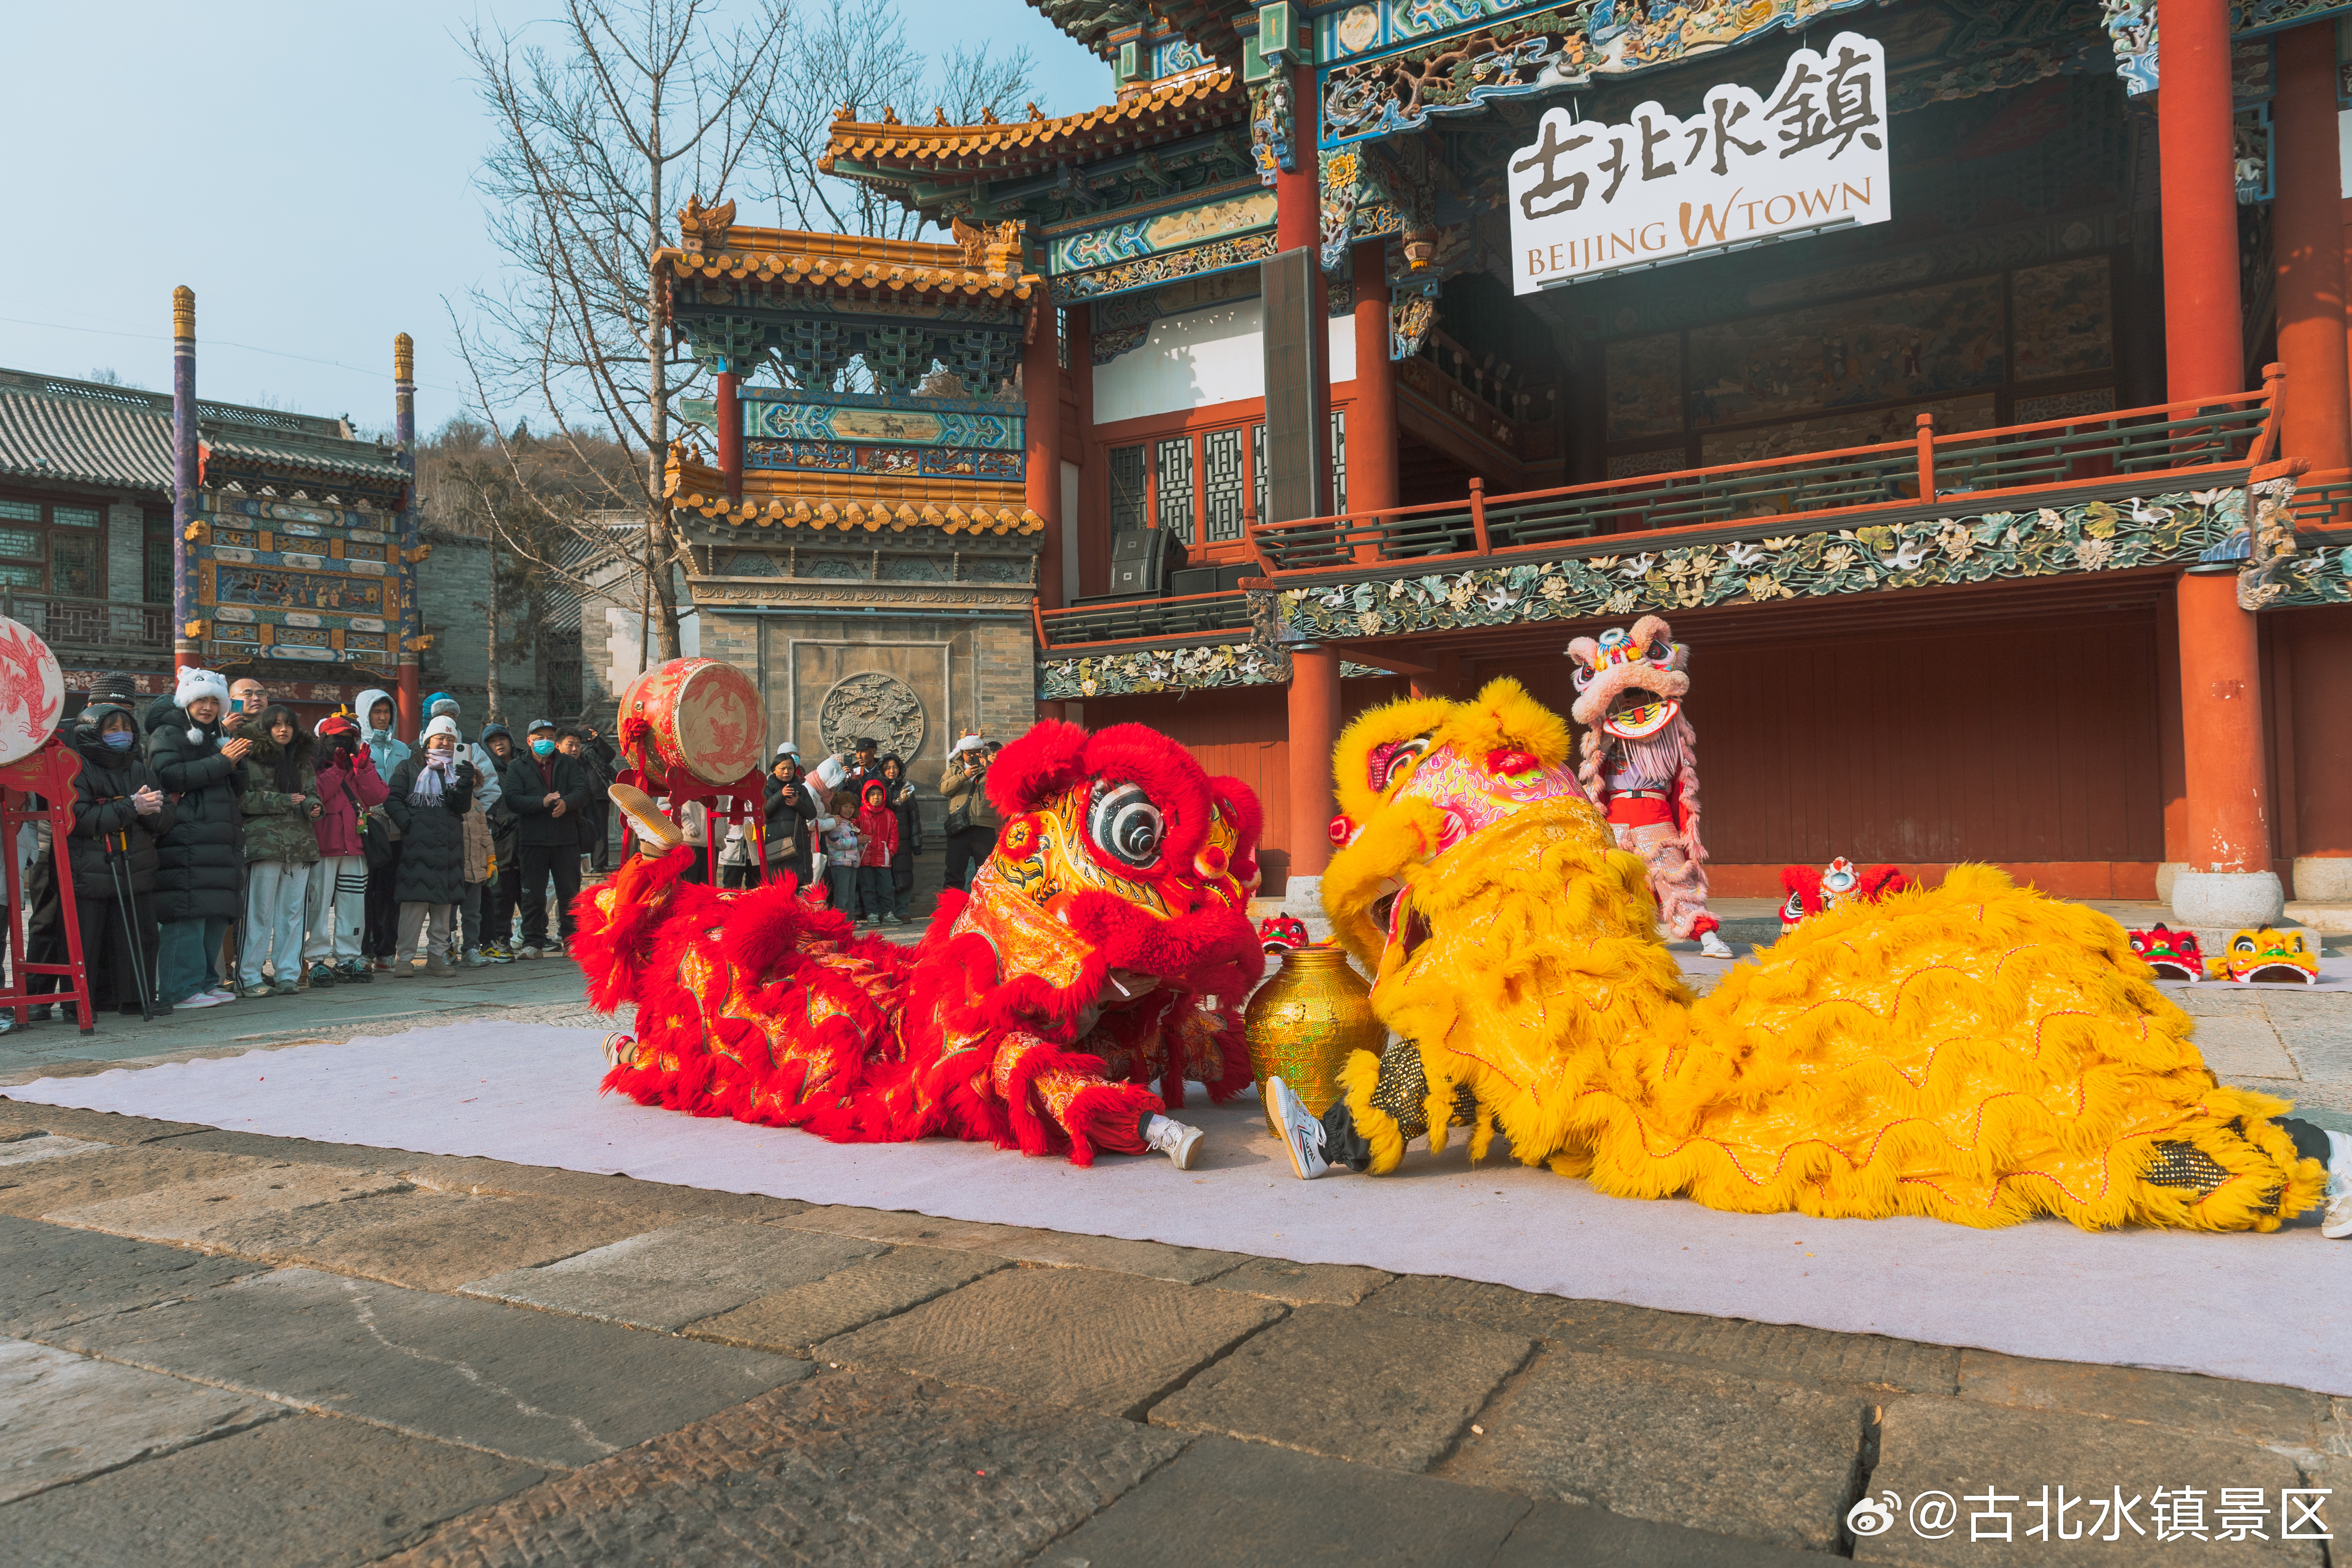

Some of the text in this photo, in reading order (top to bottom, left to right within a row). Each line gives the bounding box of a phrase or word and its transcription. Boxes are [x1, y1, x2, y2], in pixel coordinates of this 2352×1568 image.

[1513, 46, 1882, 220] 古北水鎮
[1527, 222, 1666, 276] BEIJING
